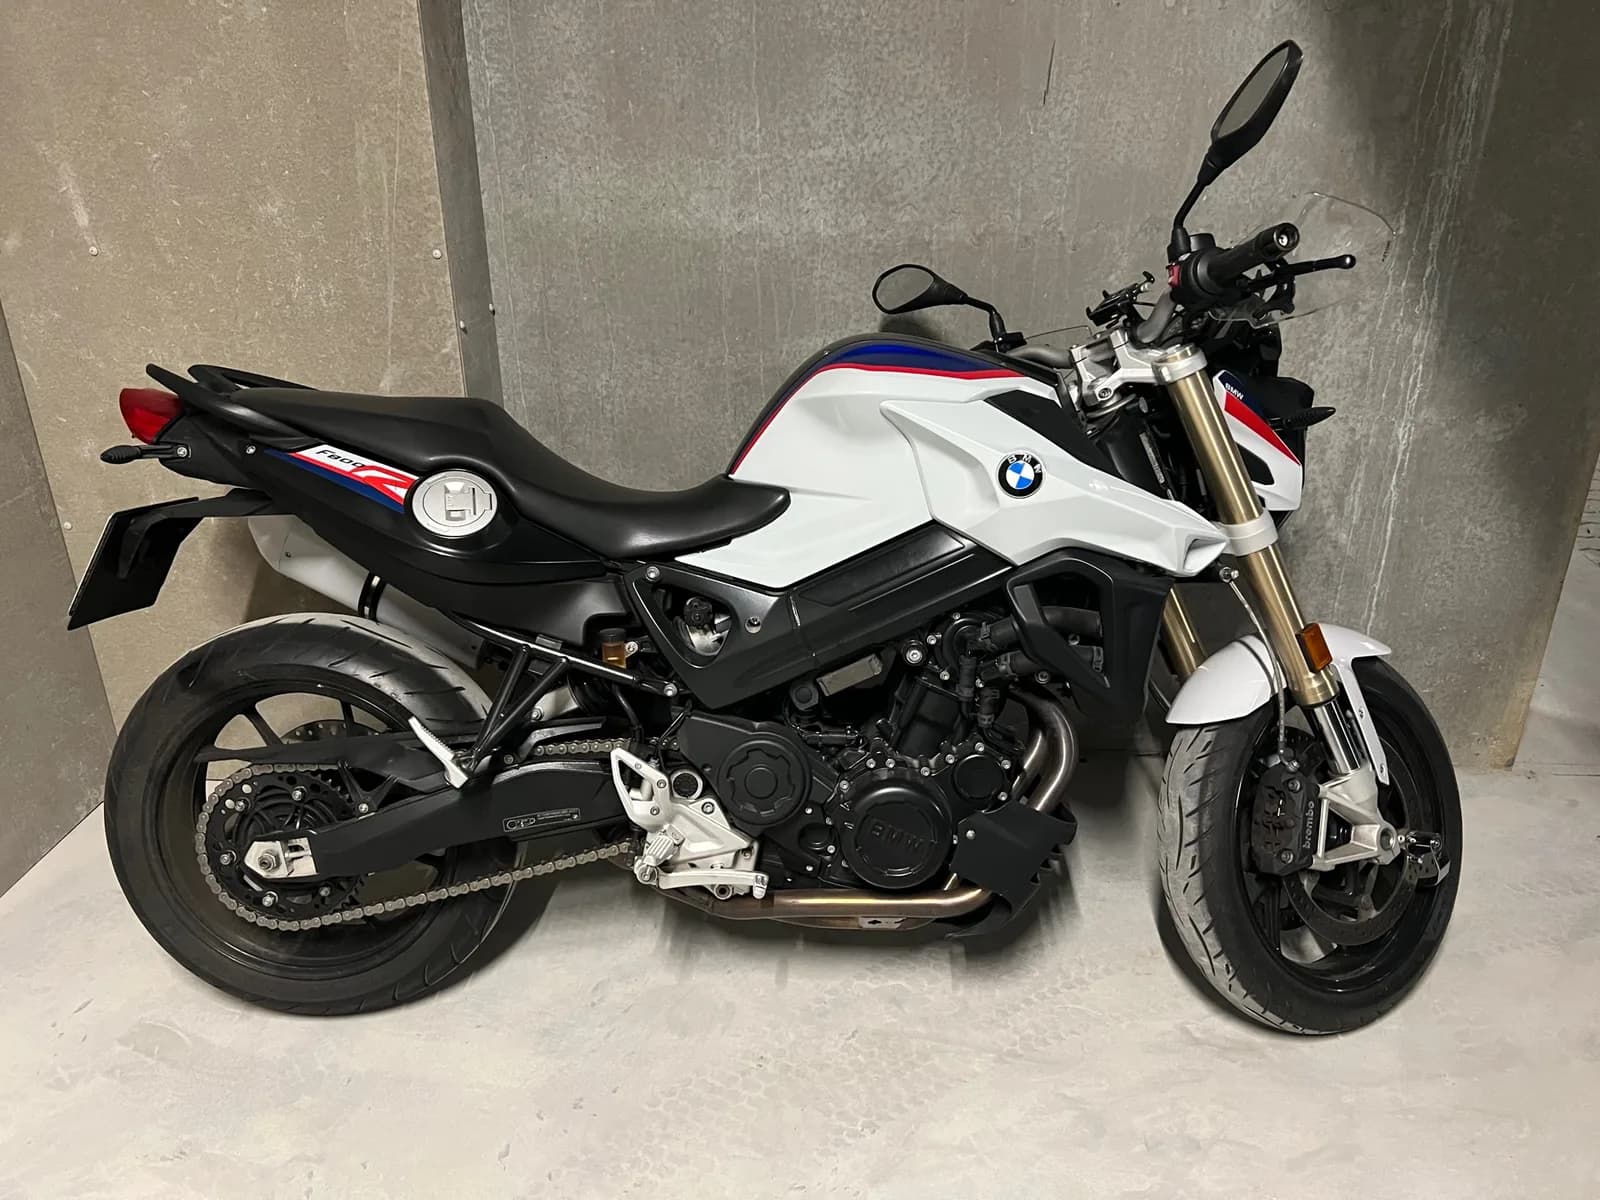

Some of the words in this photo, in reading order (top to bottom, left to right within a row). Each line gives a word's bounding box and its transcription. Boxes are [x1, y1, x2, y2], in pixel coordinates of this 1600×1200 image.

[1225, 382, 1244, 400] BMW
[1007, 453, 1042, 473] BMW
[1302, 801, 1315, 849] brembo
